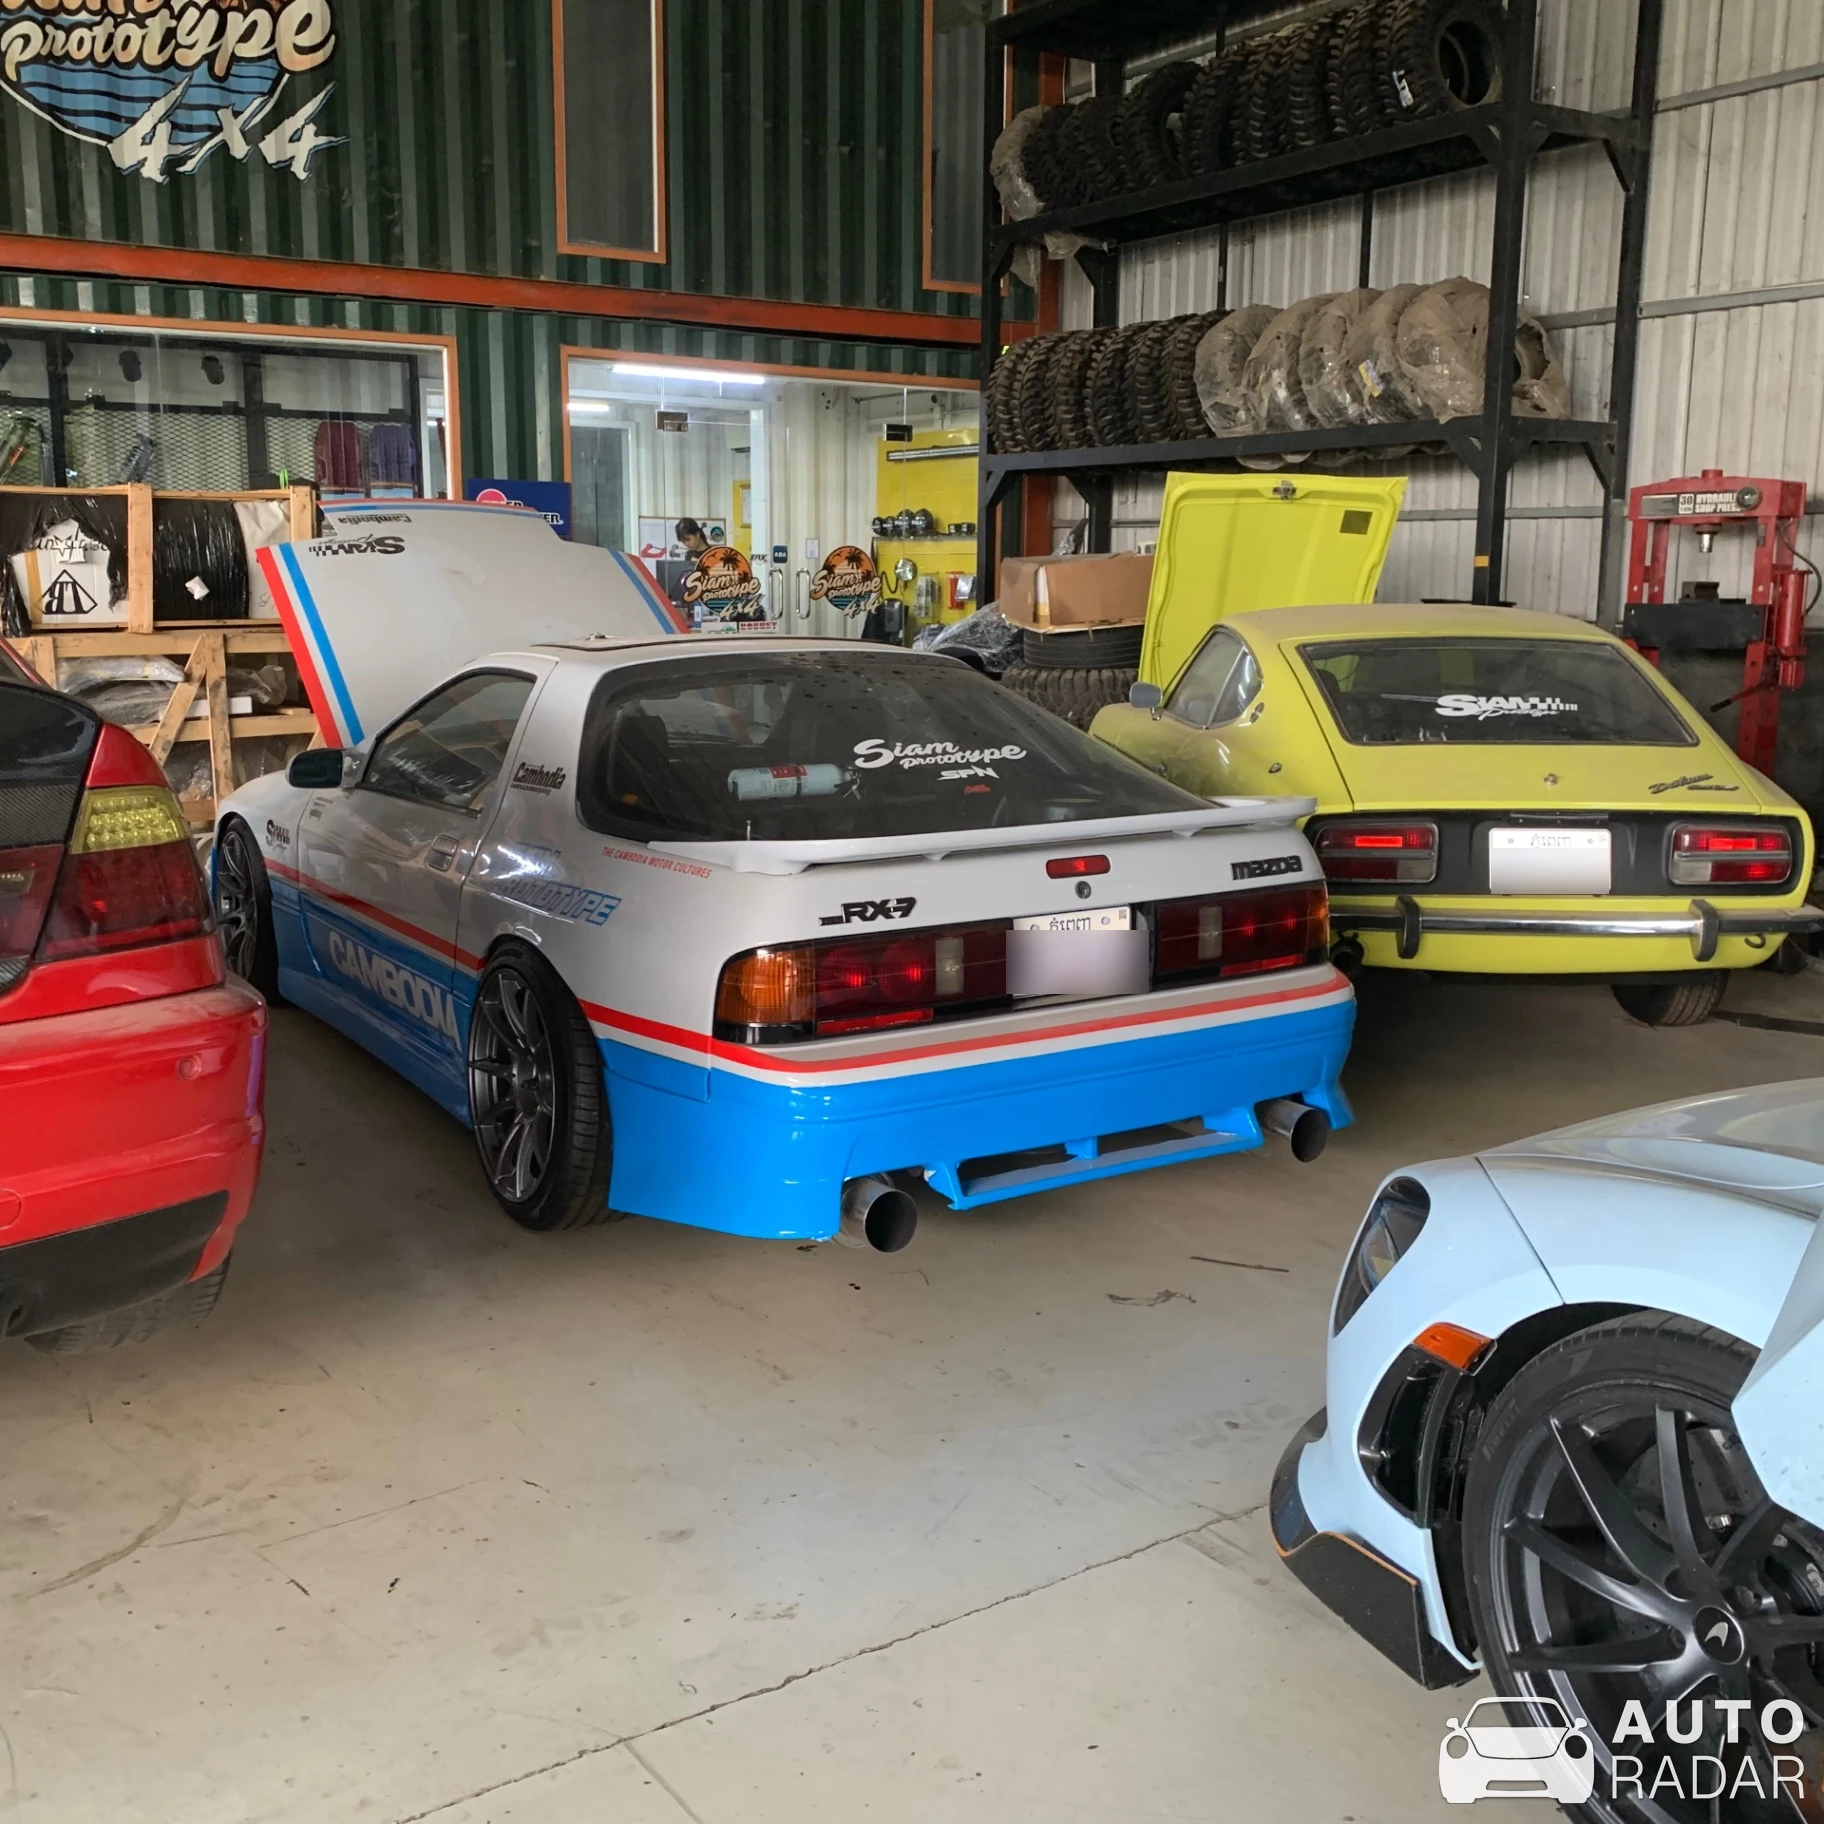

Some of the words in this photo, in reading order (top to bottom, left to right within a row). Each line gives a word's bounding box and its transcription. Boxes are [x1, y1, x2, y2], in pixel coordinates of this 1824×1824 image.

[1681, 496, 1692, 505] 30
[1695, 503, 1716, 513] SHOP
[1696, 493, 1738, 503] HYDRAULI
[684, 571, 733, 602] Siam
[810, 570, 857, 600] Siam
[853, 738, 960, 769] Siam
[513, 761, 566, 790] Cambodia
[937, 765, 1000, 781] SPN
[602, 846, 616, 858] THE
[614, 850, 649, 865] CAMBODIA
[647, 856, 674, 870] MOTOR
[673, 862, 713, 879] CULTURES
[841, 897, 917, 923] RX-7
[329, 931, 463, 1053] CAMBODIA
